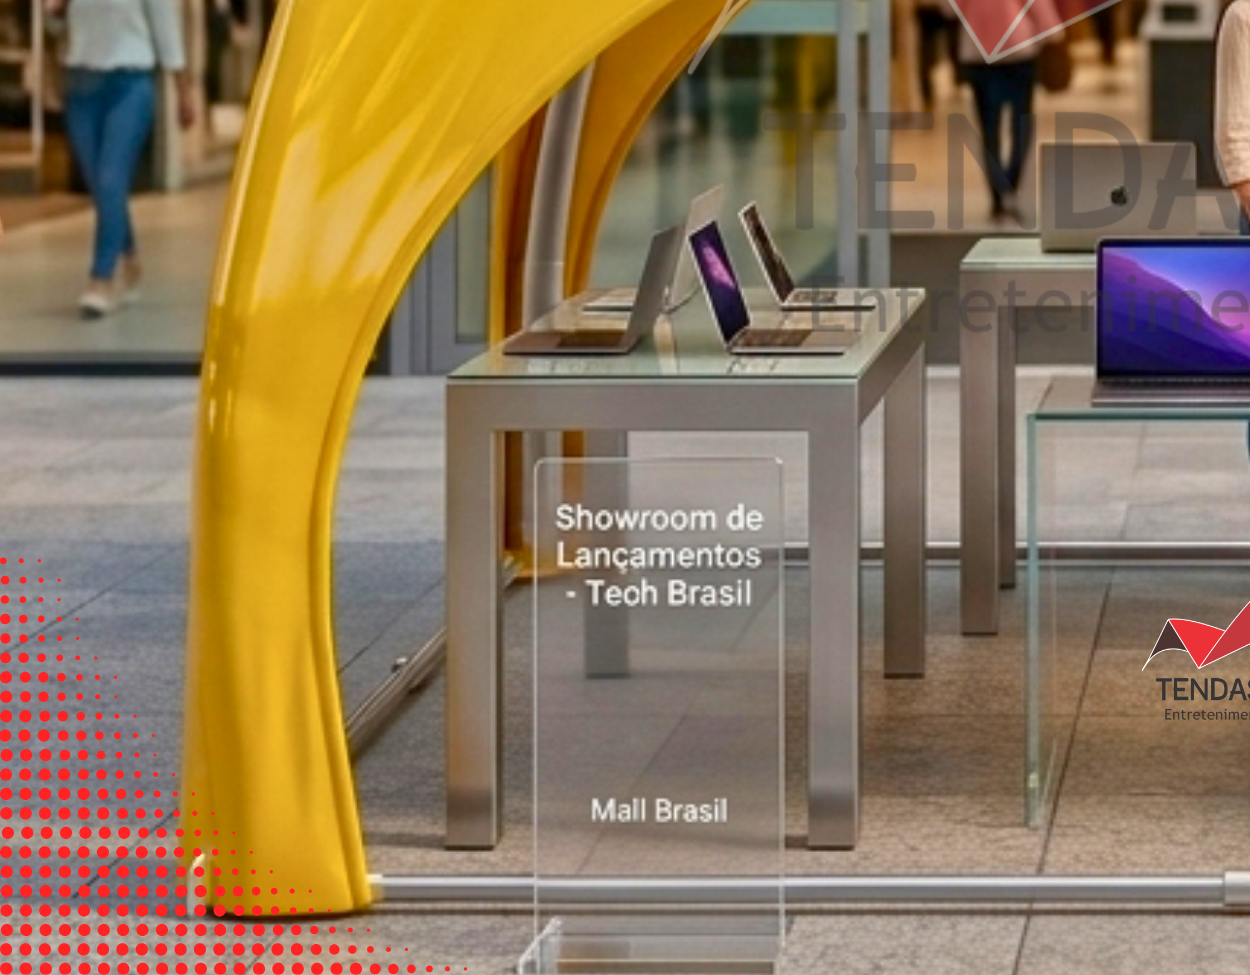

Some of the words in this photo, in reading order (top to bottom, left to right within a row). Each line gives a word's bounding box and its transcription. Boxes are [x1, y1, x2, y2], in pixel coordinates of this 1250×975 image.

[555, 503, 717, 532] Showroom
[726, 503, 765, 532] de
[556, 540, 763, 575] Lançamentos
[667, 578, 752, 607] Brasil
[591, 797, 647, 823] Mall
[655, 797, 728, 823] Brasil
